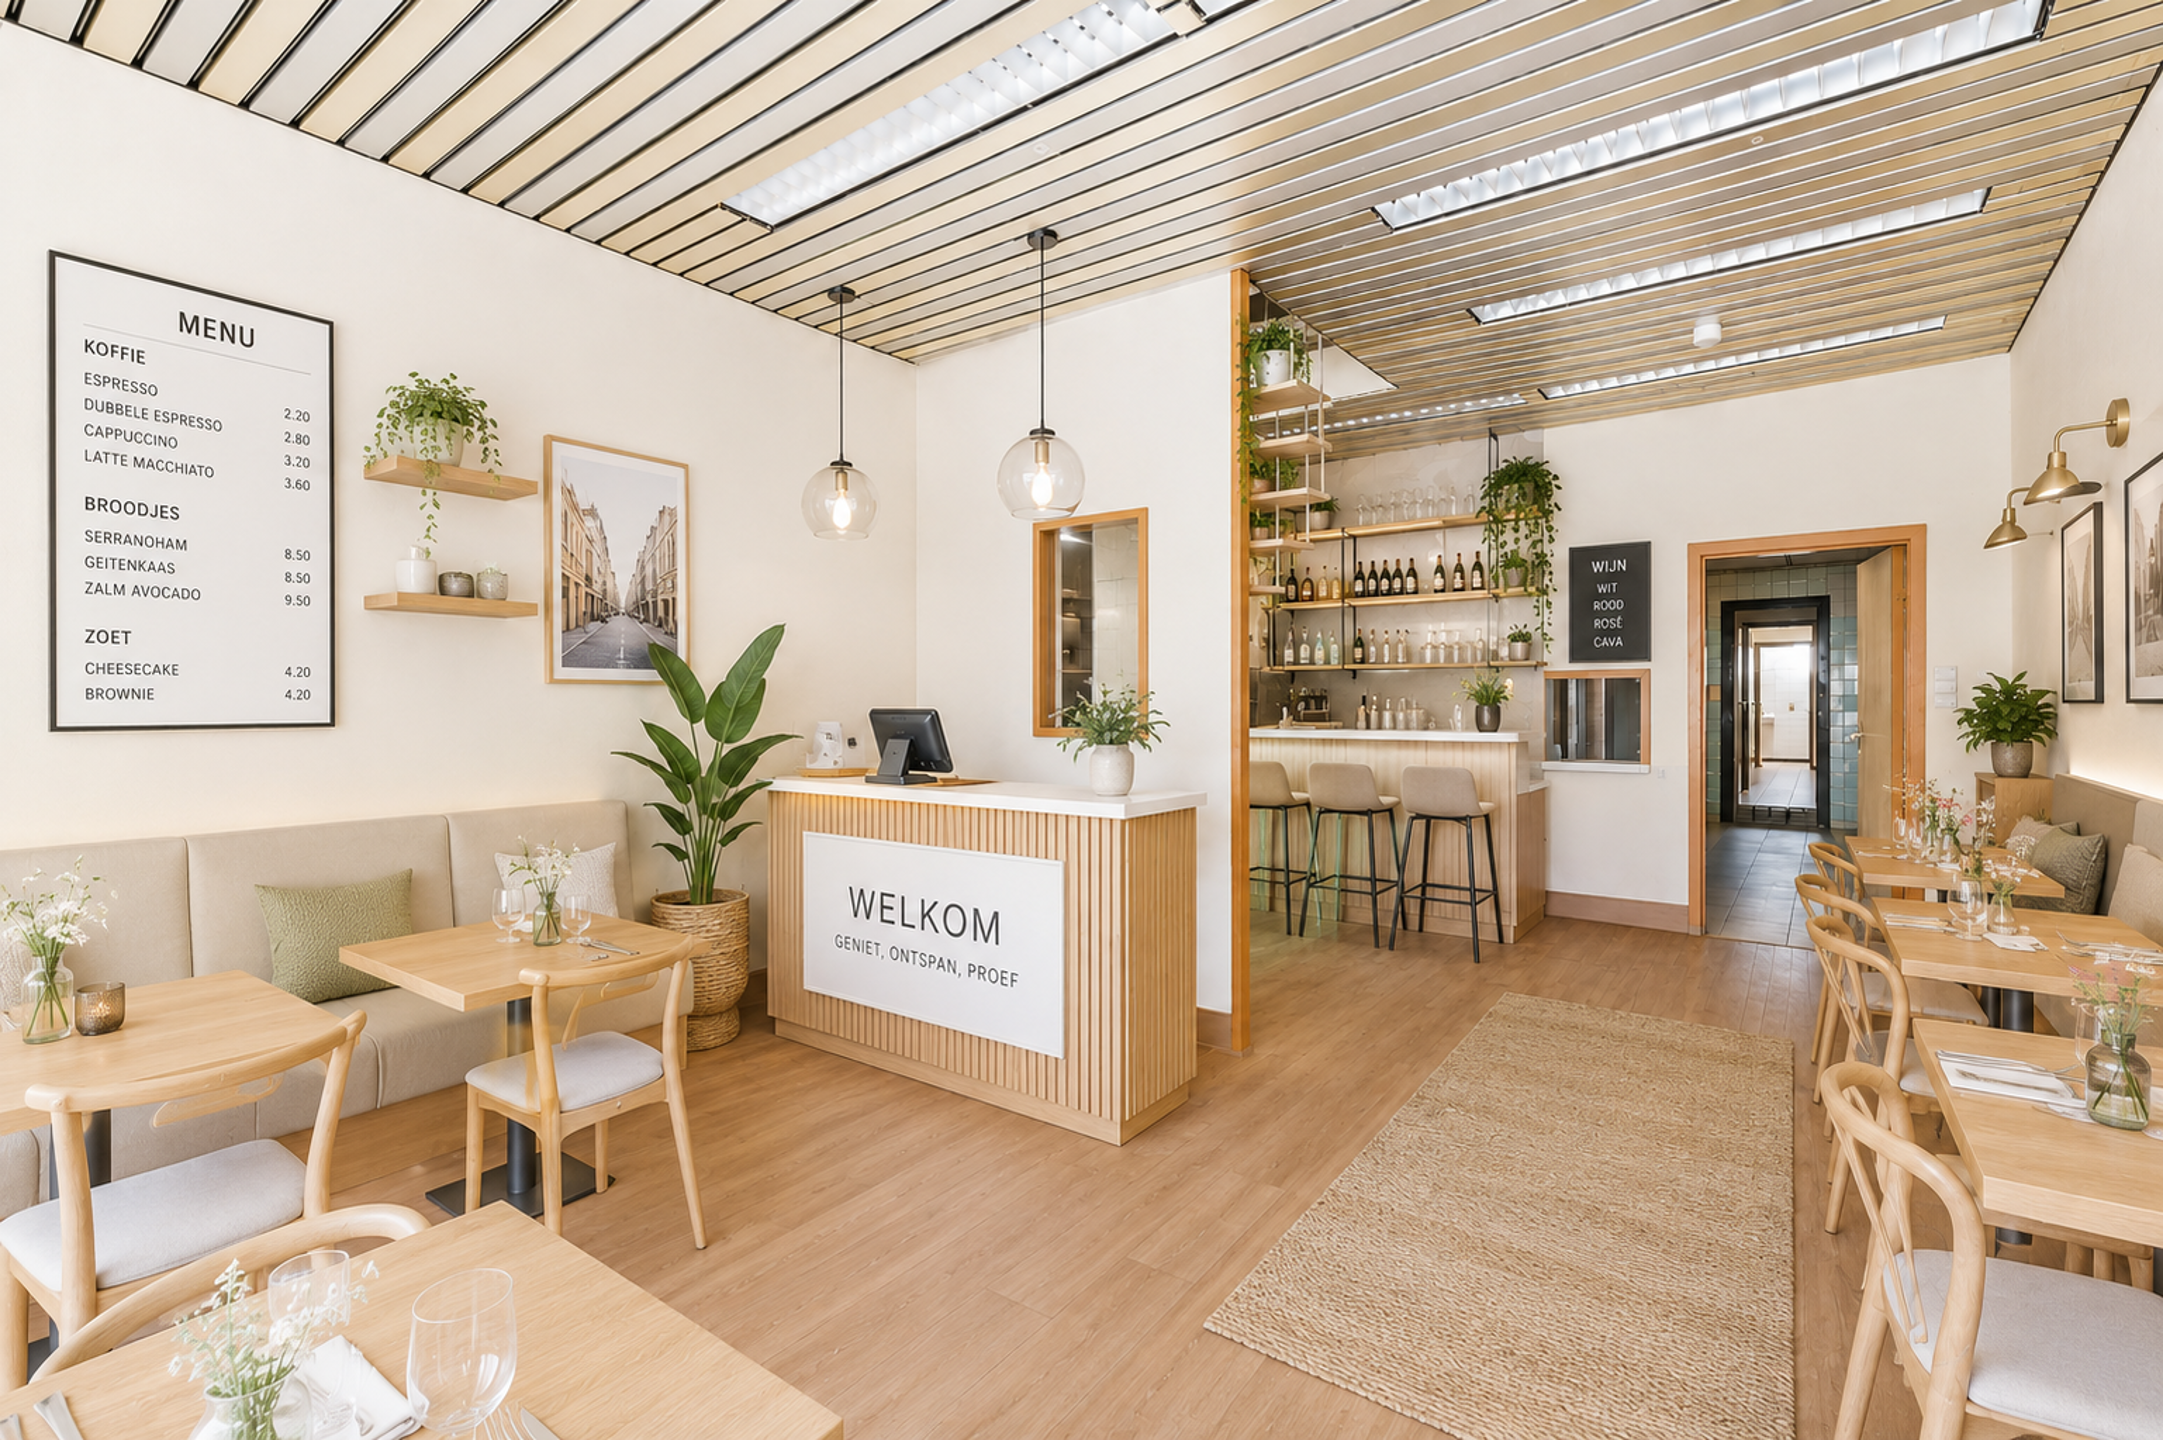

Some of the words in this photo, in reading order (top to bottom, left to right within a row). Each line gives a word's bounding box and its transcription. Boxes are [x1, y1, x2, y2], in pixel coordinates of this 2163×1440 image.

[179, 311, 255, 348] MENU
[84, 339, 146, 365] KOFFIE
[84, 372, 159, 396] ESPRESSO
[283, 408, 311, 422] 2.20
[84, 398, 149, 420] DUBBELE
[153, 410, 223, 432] ESPRESSO
[284, 431, 311, 446] 2.80
[83, 424, 179, 449] CAPPUCCINO
[283, 455, 311, 468] 3.20
[84, 449, 129, 466] LATTE
[133, 456, 215, 478] MACCHIATO
[284, 477, 311, 491] 3.60
[84, 496, 180, 520] BROODJES
[84, 530, 188, 551] SERRANOHAM
[284, 549, 311, 561] 8.50
[84, 556, 176, 574] GEITENKAAS
[284, 572, 311, 584] 8.50
[1591, 558, 1627, 573] WIJN
[84, 581, 126, 595] ZALM
[130, 585, 201, 600] AVOCADO
[284, 594, 311, 606] 9.50
[1596, 582, 1618, 593] WIT
[1593, 599, 1625, 610] ROOD
[1593, 615, 1623, 629] ROSÉ
[84, 629, 132, 644] ZOET
[1593, 636, 1624, 647] CAVA
[84, 662, 180, 676] CHEESECAKE
[284, 667, 312, 677] 4.20
[85, 688, 155, 700] BROWNIE
[284, 689, 312, 700] 4.20
[848, 886, 1000, 945] WELKOM
[834, 934, 885, 959] GENIET,
[889, 946, 962, 977] ONTSPAN,
[967, 963, 1019, 987] PROEF
